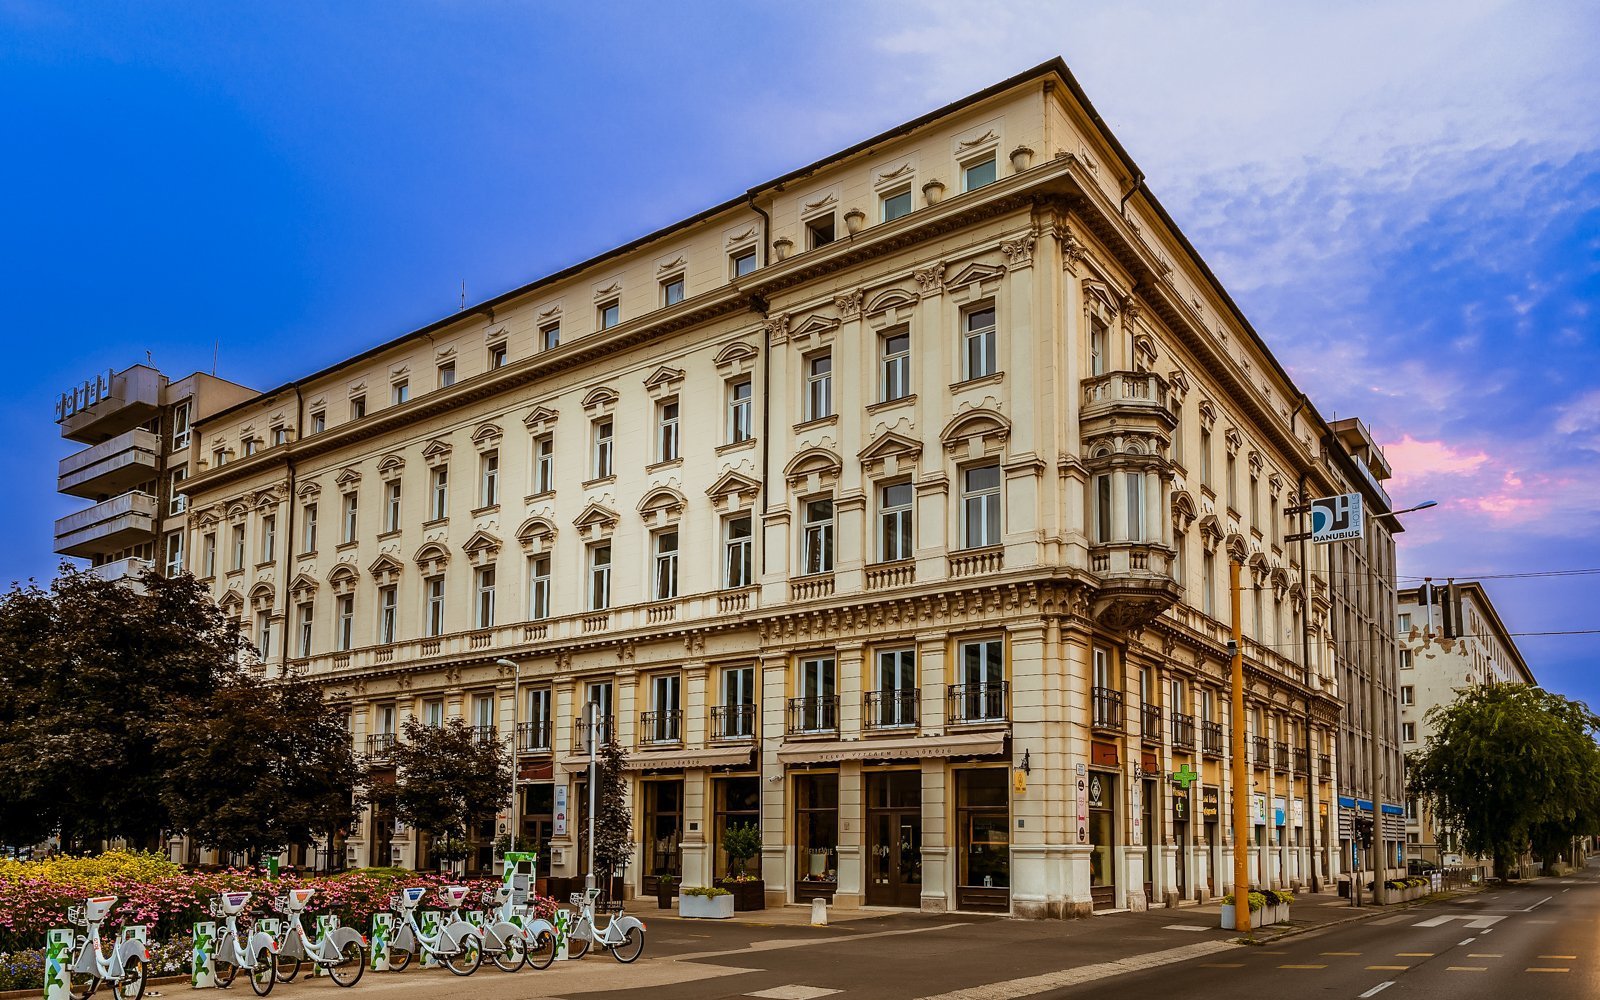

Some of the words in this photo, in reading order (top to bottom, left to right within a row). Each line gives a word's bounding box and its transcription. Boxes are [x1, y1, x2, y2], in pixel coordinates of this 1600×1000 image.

[55, 375, 109, 417] HOTEL
[1352, 493, 1360, 528] HOTELS
[1313, 530, 1360, 542] DANUBIUS
